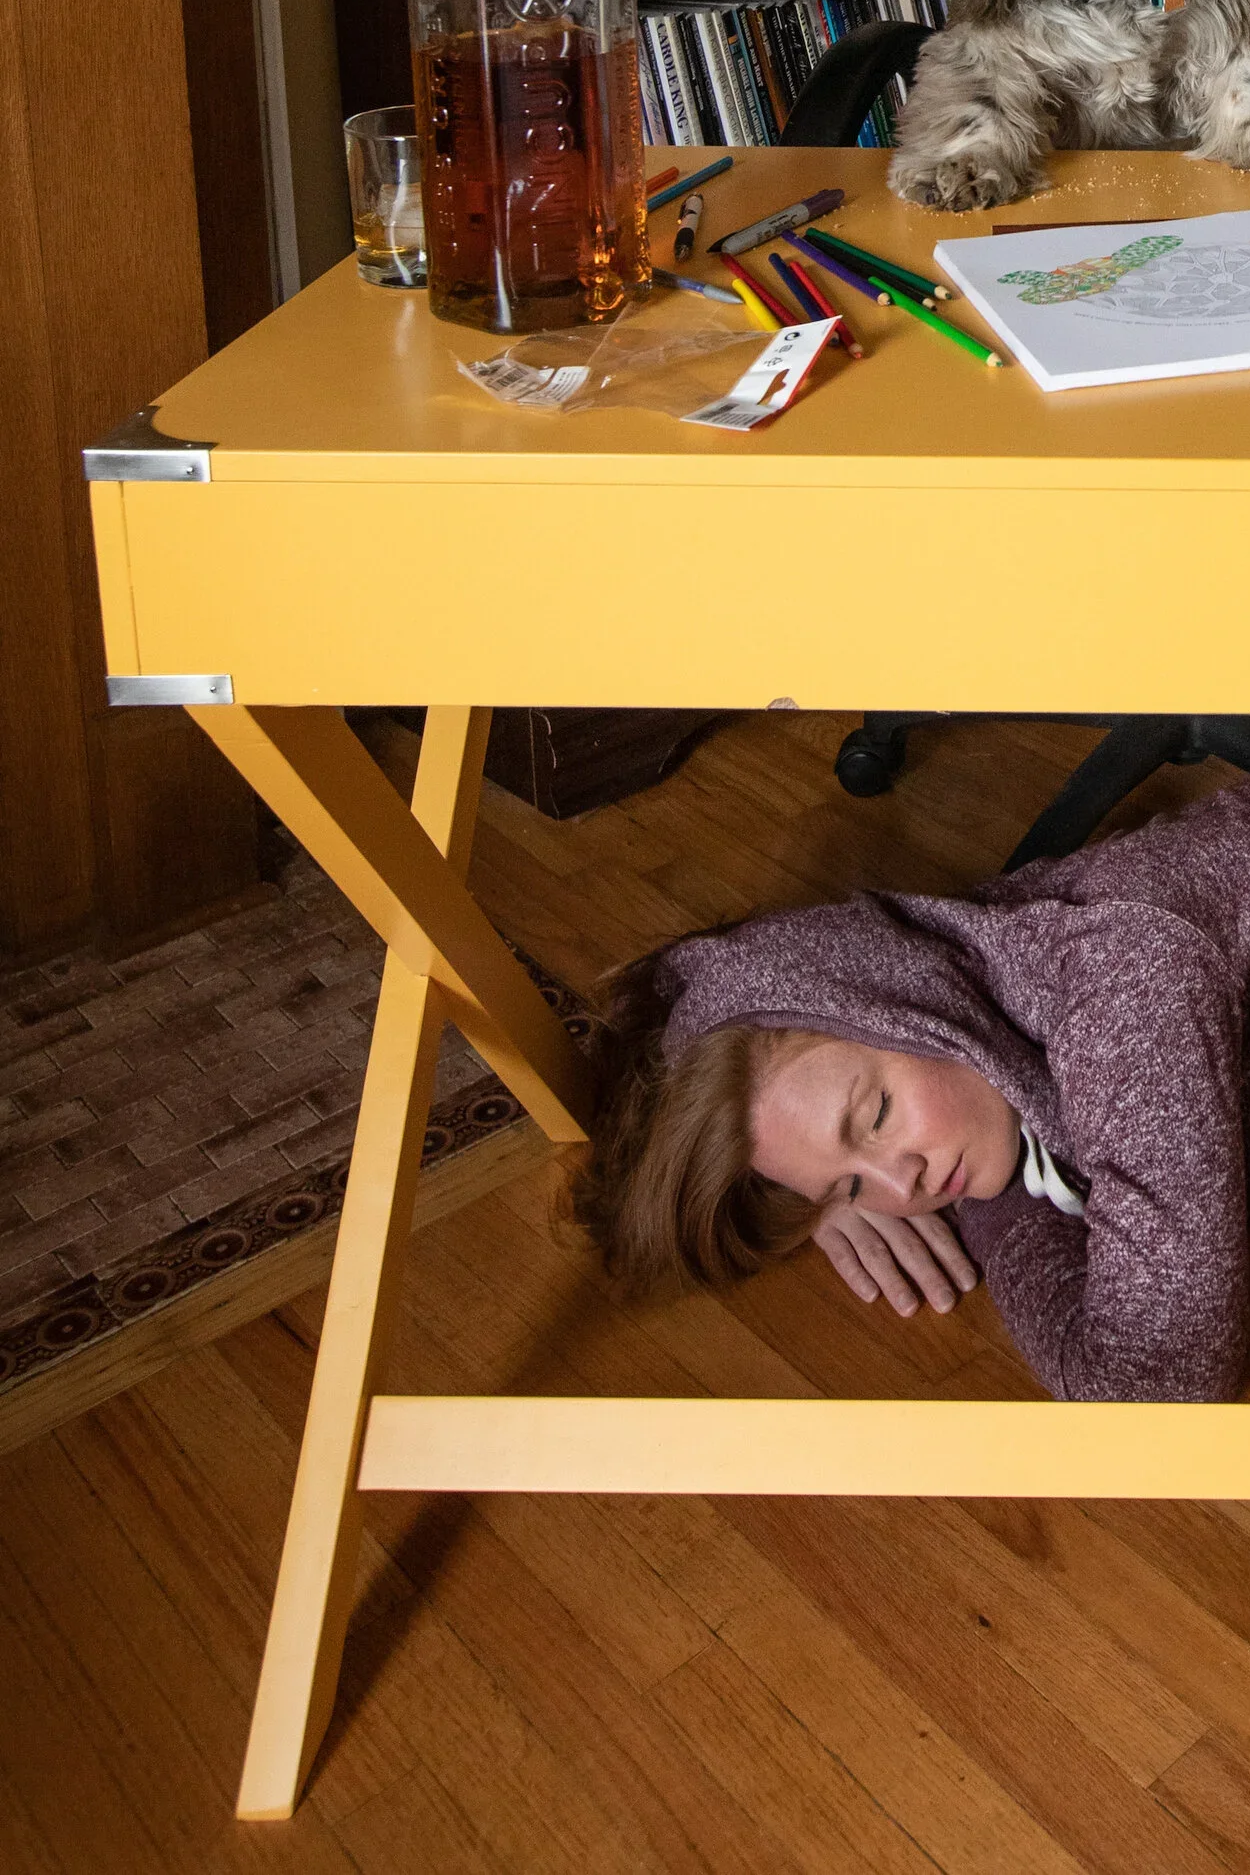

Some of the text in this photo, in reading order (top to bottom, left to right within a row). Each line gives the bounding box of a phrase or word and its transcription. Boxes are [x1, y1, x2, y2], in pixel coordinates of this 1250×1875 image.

[771, 16, 781, 30] THE
[749, 47, 759, 64] AND
[774, 30, 788, 62] STEPHEN
[656, 22, 677, 87] CAROLE
[670, 89, 688, 129] KING
[722, 45, 737, 85] MITCHELL
[733, 87, 753, 139] ANTHOLOGY
[737, 56, 757, 109] MICHAEL JOHN
[753, 63, 764, 87] HART
[723, 94, 739, 143] Collection
